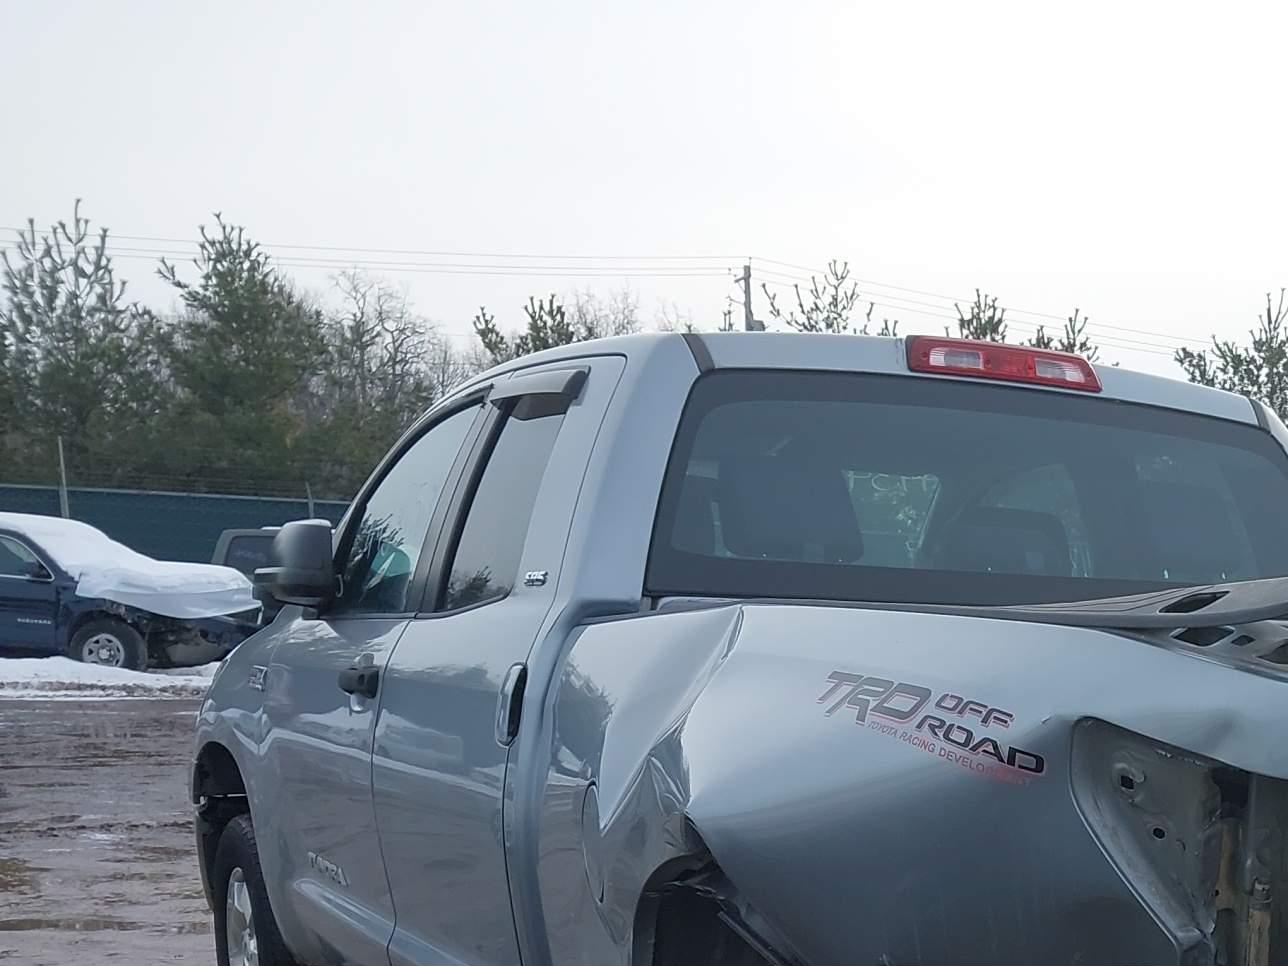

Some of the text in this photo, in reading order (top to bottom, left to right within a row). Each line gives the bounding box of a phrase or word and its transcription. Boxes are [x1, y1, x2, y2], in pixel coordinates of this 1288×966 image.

[815, 670, 1015, 729] TRD OFF
[898, 731, 936, 753] RACING
[915, 713, 1046, 775] ROAD
